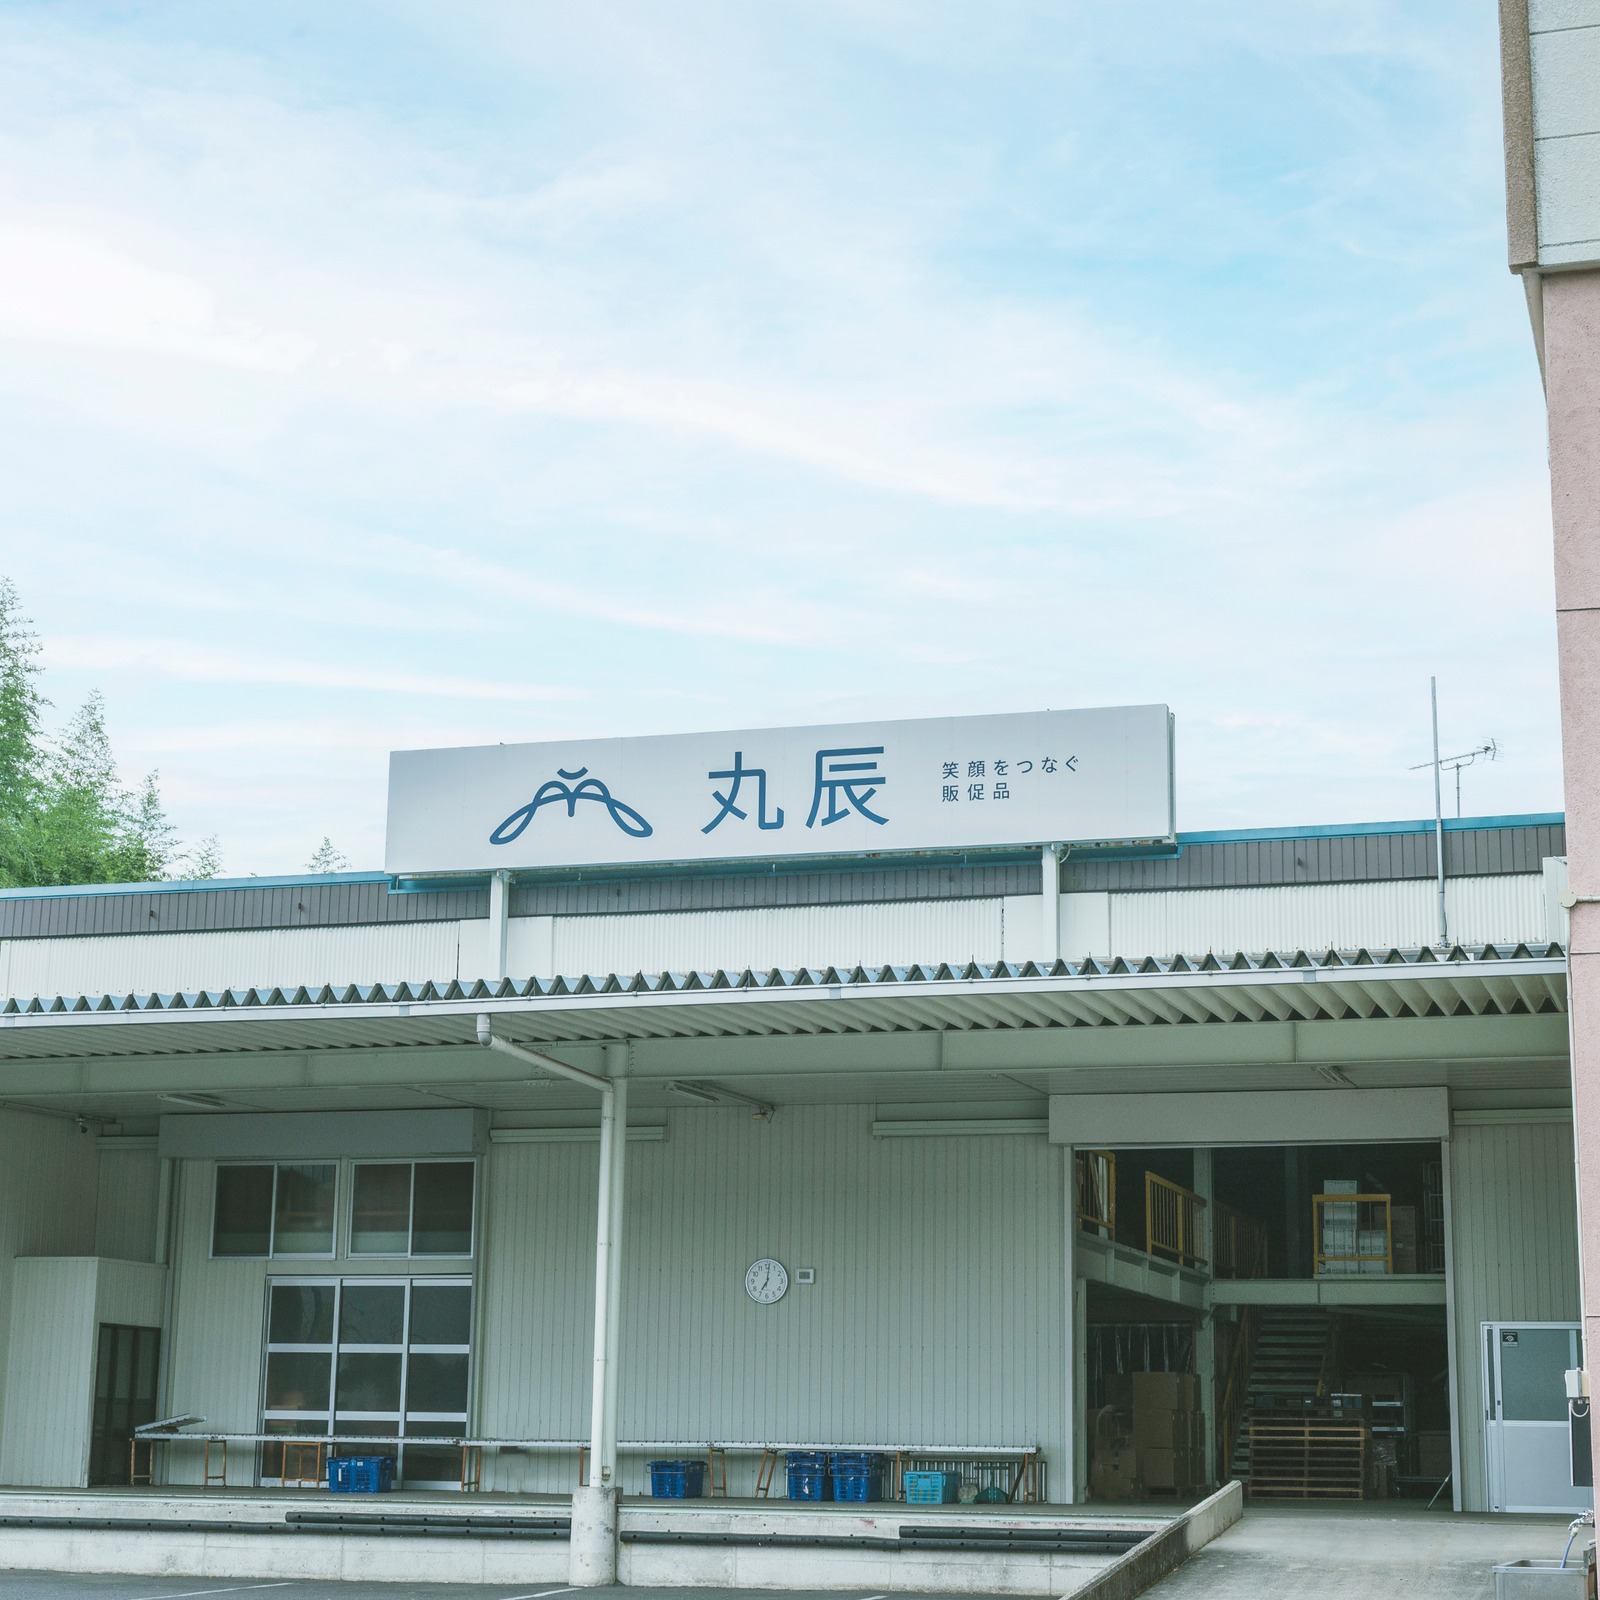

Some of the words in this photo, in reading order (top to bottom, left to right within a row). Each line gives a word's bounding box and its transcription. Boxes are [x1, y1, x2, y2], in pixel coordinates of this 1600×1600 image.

[942, 755, 1079, 780] 笑顔をつなぐ
[700, 745, 890, 835] 丸辰
[942, 782, 1010, 803] 販促品
